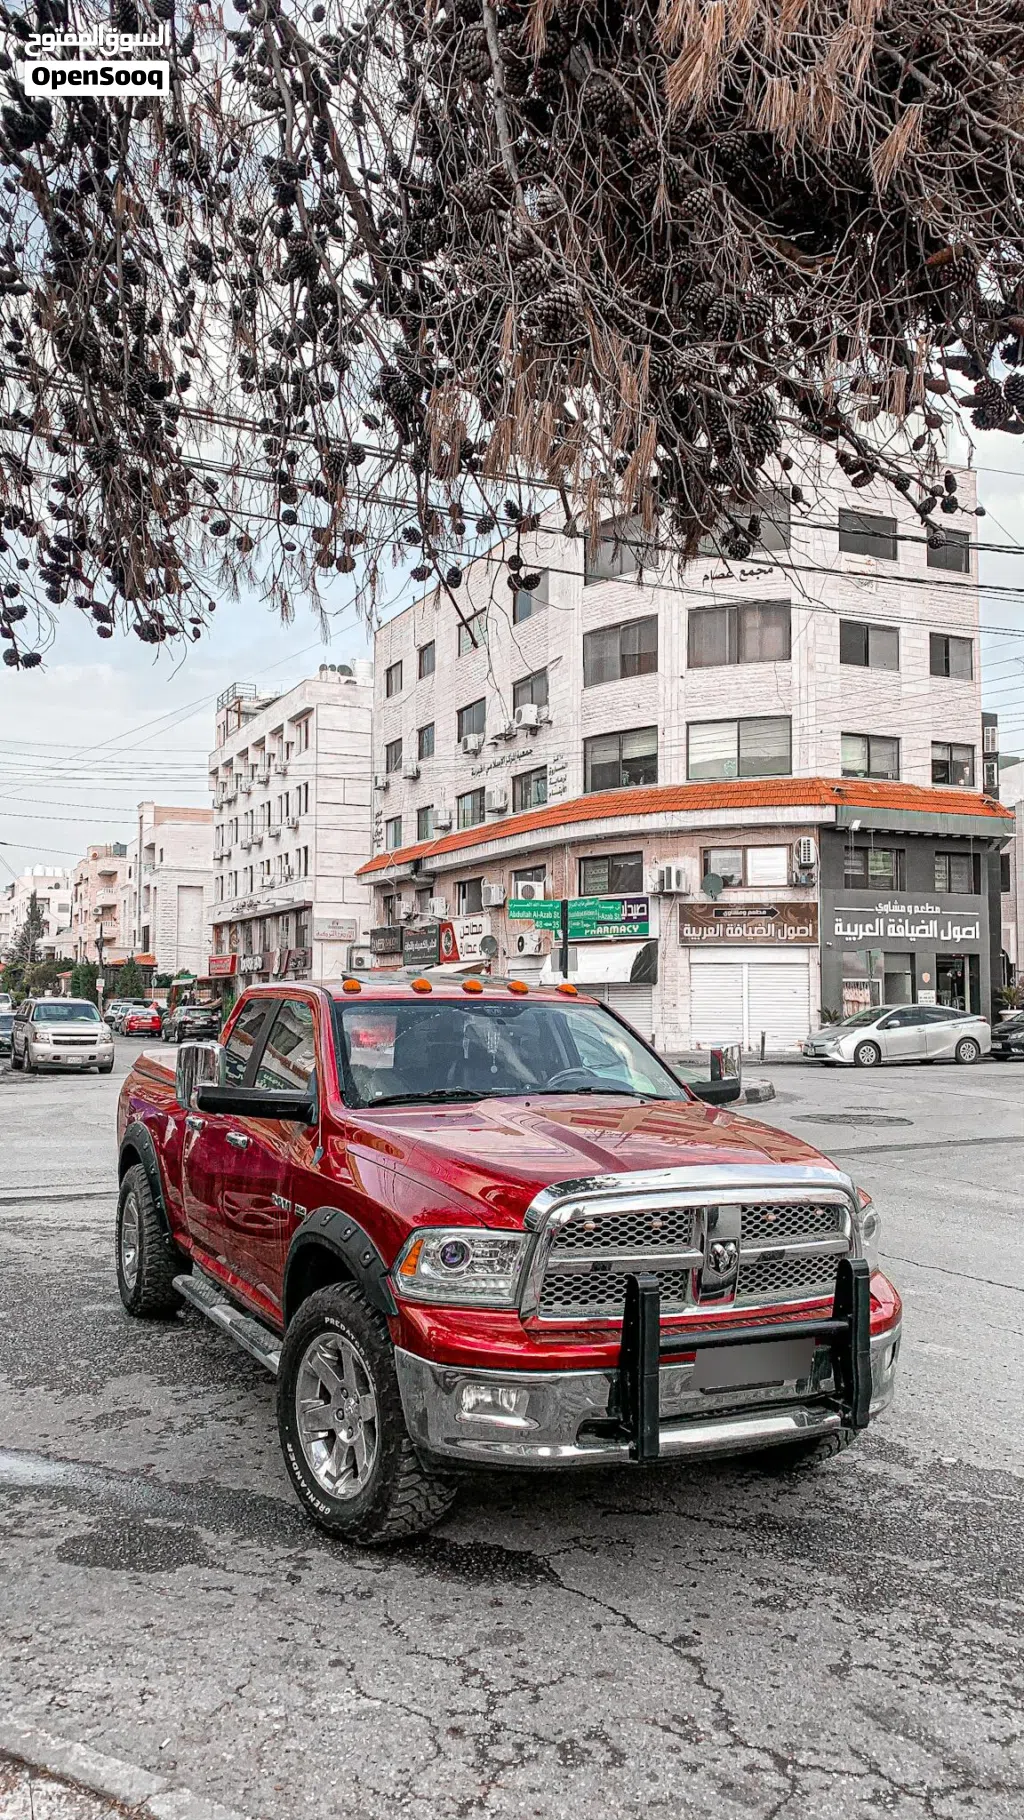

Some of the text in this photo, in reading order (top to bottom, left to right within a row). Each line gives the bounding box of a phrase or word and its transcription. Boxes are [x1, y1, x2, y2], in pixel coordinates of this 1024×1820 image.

[702, 566, 774, 587] مجمع عصام
[533, 911, 553, 919] Al-Azab
[621, 900, 647, 919] صيدلي
[875, 900, 906, 915] مشاوي
[914, 902, 941, 915] مطعم
[460, 921, 483, 939] مطاحن
[585, 925, 640, 935] PHARMACY
[683, 923, 723, 940] العربية
[725, 923, 775, 940] الضيافة
[834, 917, 980, 943] اصول الضيافة العربية
[324, 1316, 366, 1356] PREDATOR
[286, 1442, 331, 1515] GRENLANDER
